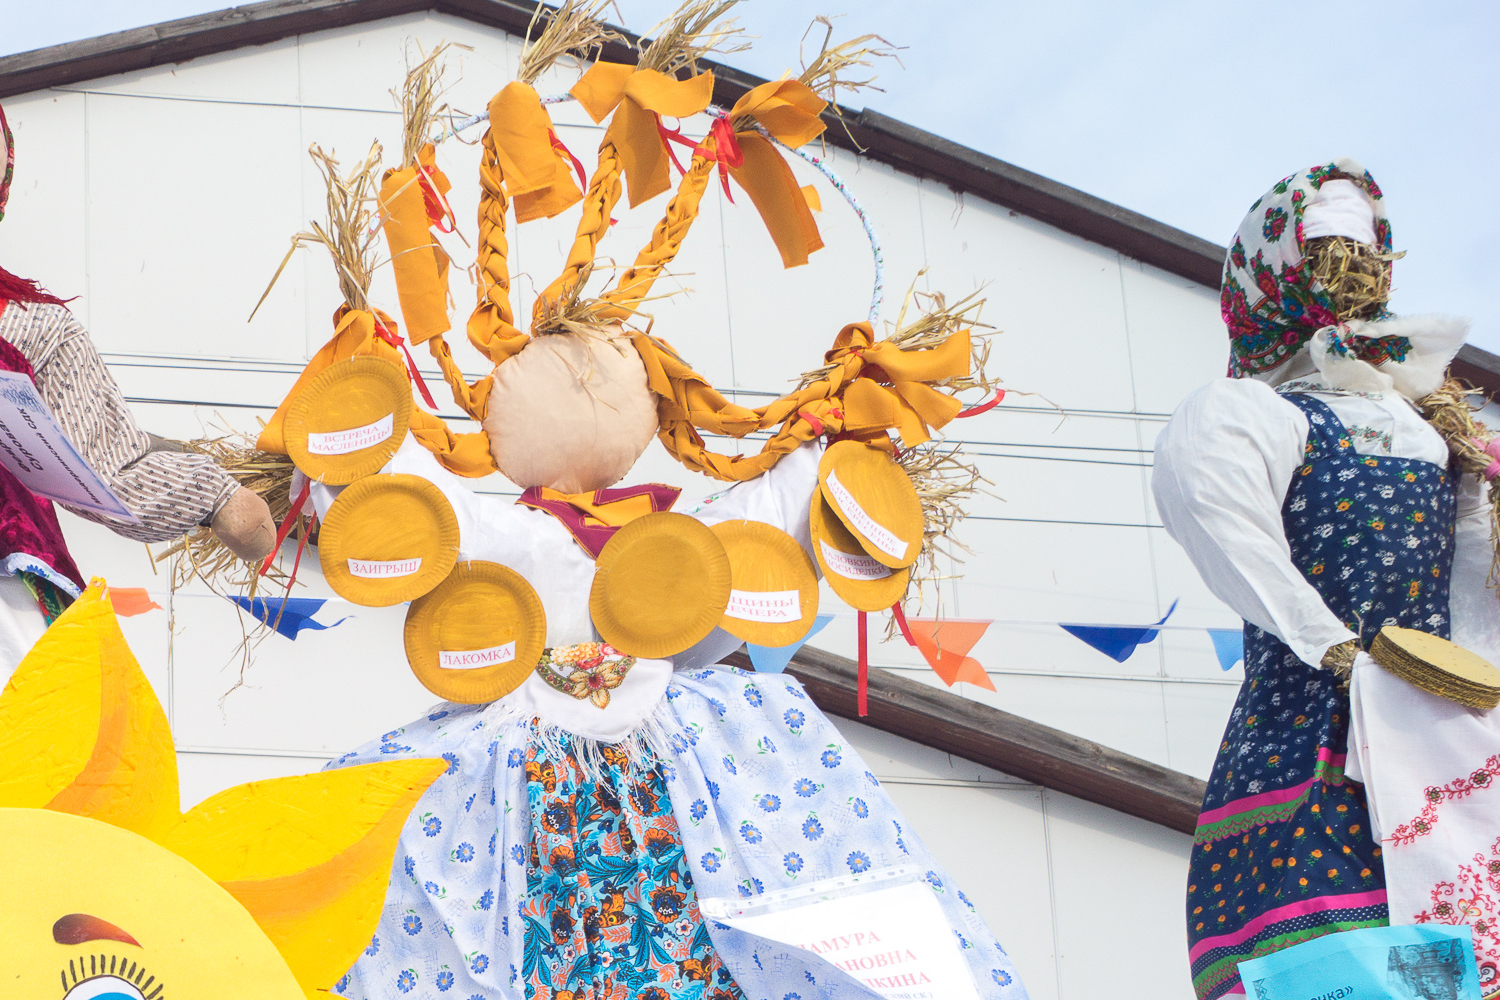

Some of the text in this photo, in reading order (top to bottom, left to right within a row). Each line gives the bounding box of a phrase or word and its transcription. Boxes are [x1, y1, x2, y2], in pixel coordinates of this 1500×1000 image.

[311, 425, 390, 452] МАСЛЕНИЦЫ
[324, 425, 379, 443] ВСТРЕЧА
[16, 406, 103, 505] Миндерлинский СДК
[352, 560, 417, 574] ЗАИГРЫШ
[825, 558, 886, 576] ПОСИДЕЛКИ
[442, 647, 512, 665] ЛАКОМКА
